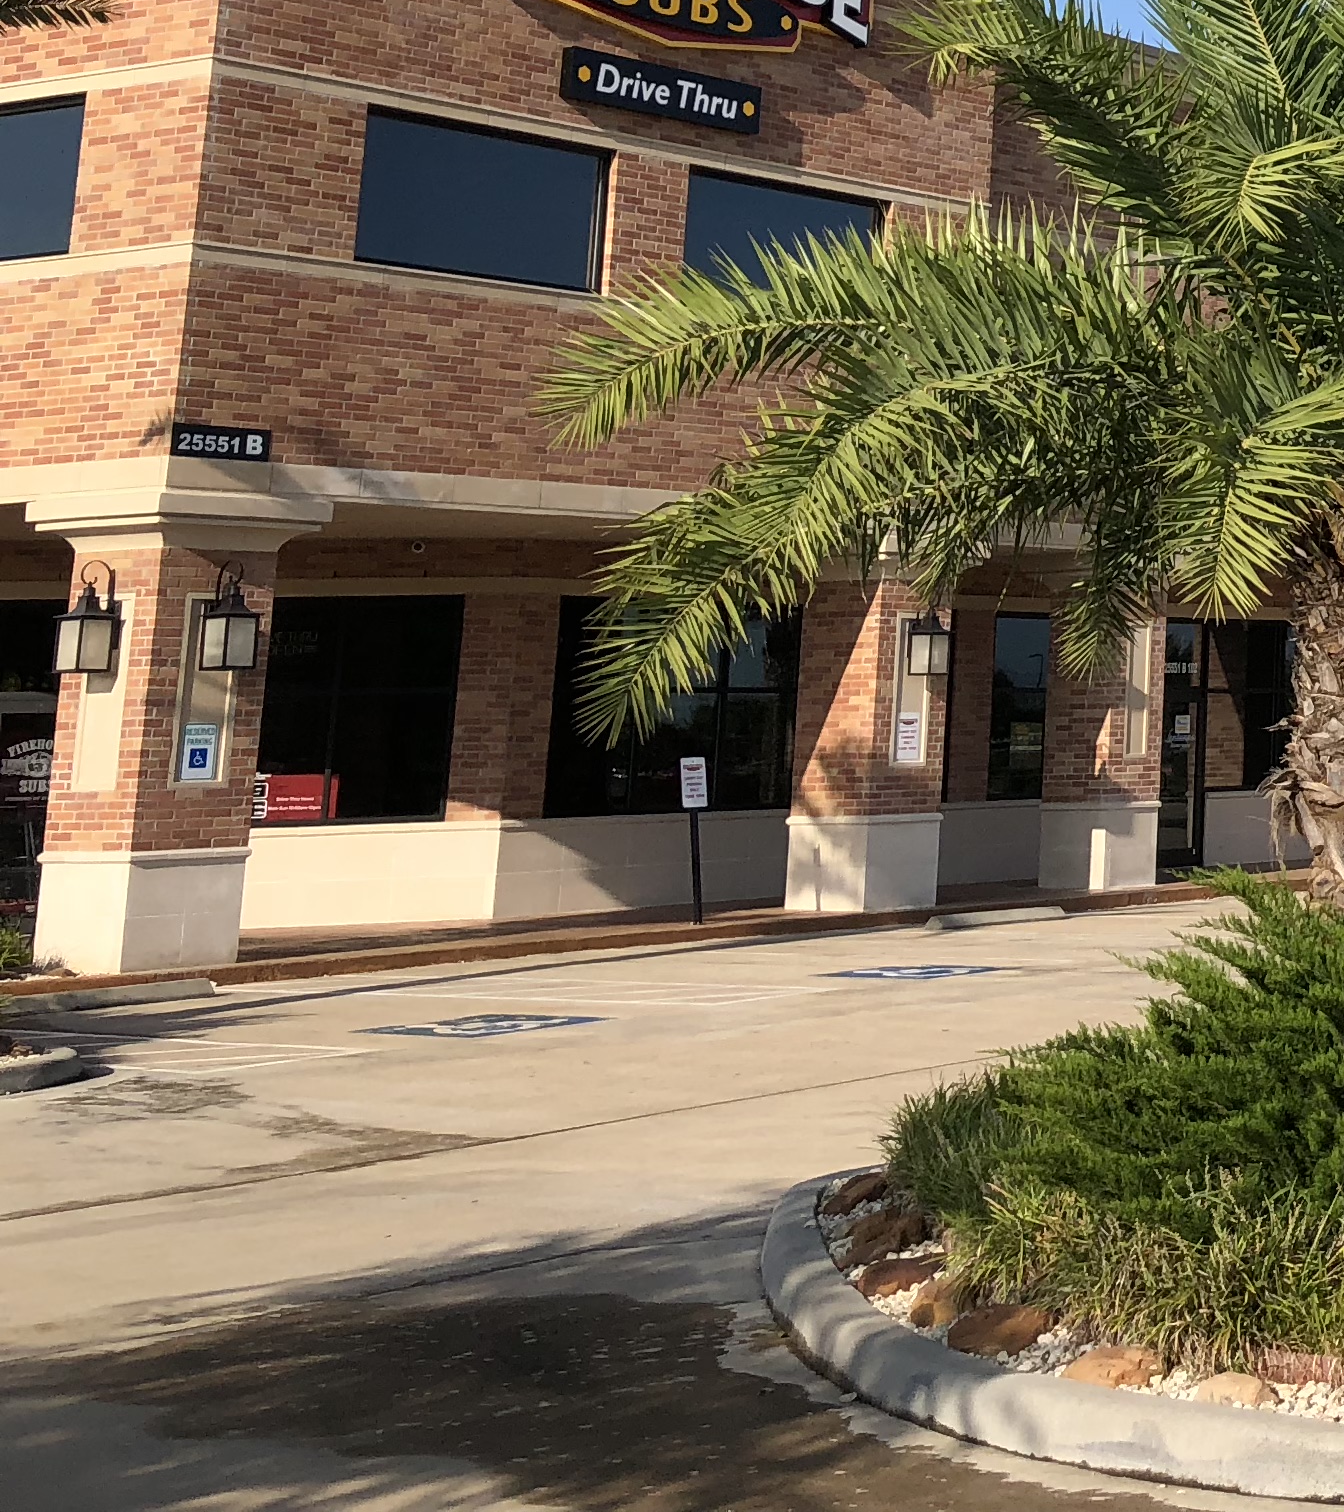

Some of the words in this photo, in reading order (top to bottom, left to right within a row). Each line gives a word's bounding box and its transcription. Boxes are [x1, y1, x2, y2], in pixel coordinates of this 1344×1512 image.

[595, 62, 671, 106] Drive
[676, 79, 738, 120] Thru
[177, 433, 240, 454] 25551
[245, 434, 263, 455] B
[18, 779, 51, 794] SUB
